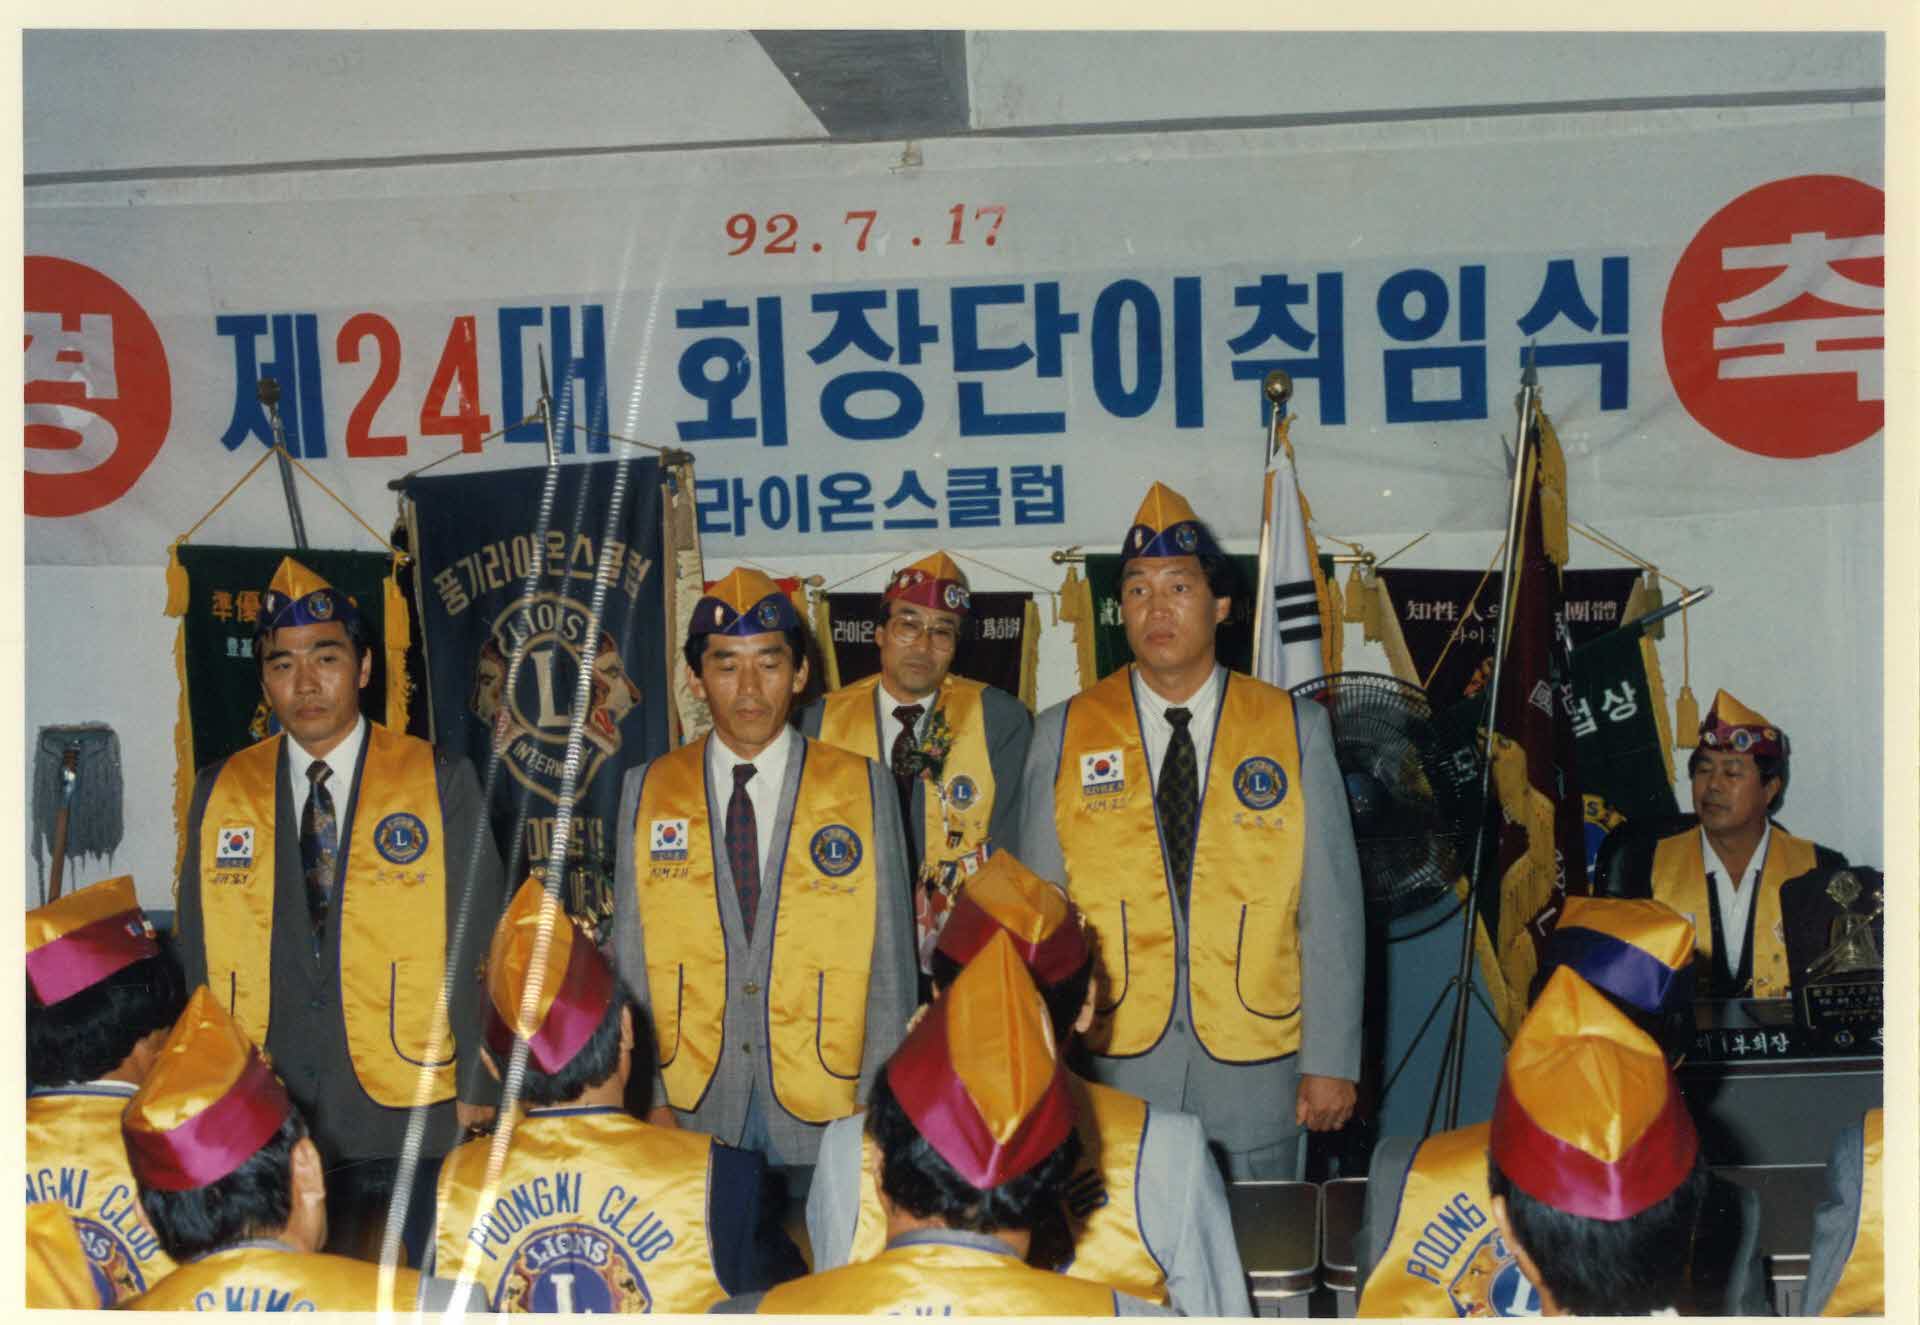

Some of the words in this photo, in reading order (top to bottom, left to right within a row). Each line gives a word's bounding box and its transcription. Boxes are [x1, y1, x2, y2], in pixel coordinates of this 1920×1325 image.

[1713, 231, 1884, 402] 축
[215, 304, 611, 459] 제24대
[695, 464, 1065, 537] 라이온스클럽
[468, 1172, 582, 1261] POONGKI
[598, 1185, 675, 1263] CLUB
[527, 1232, 609, 1267] LIONS
[1406, 1192, 1488, 1285] POONG
